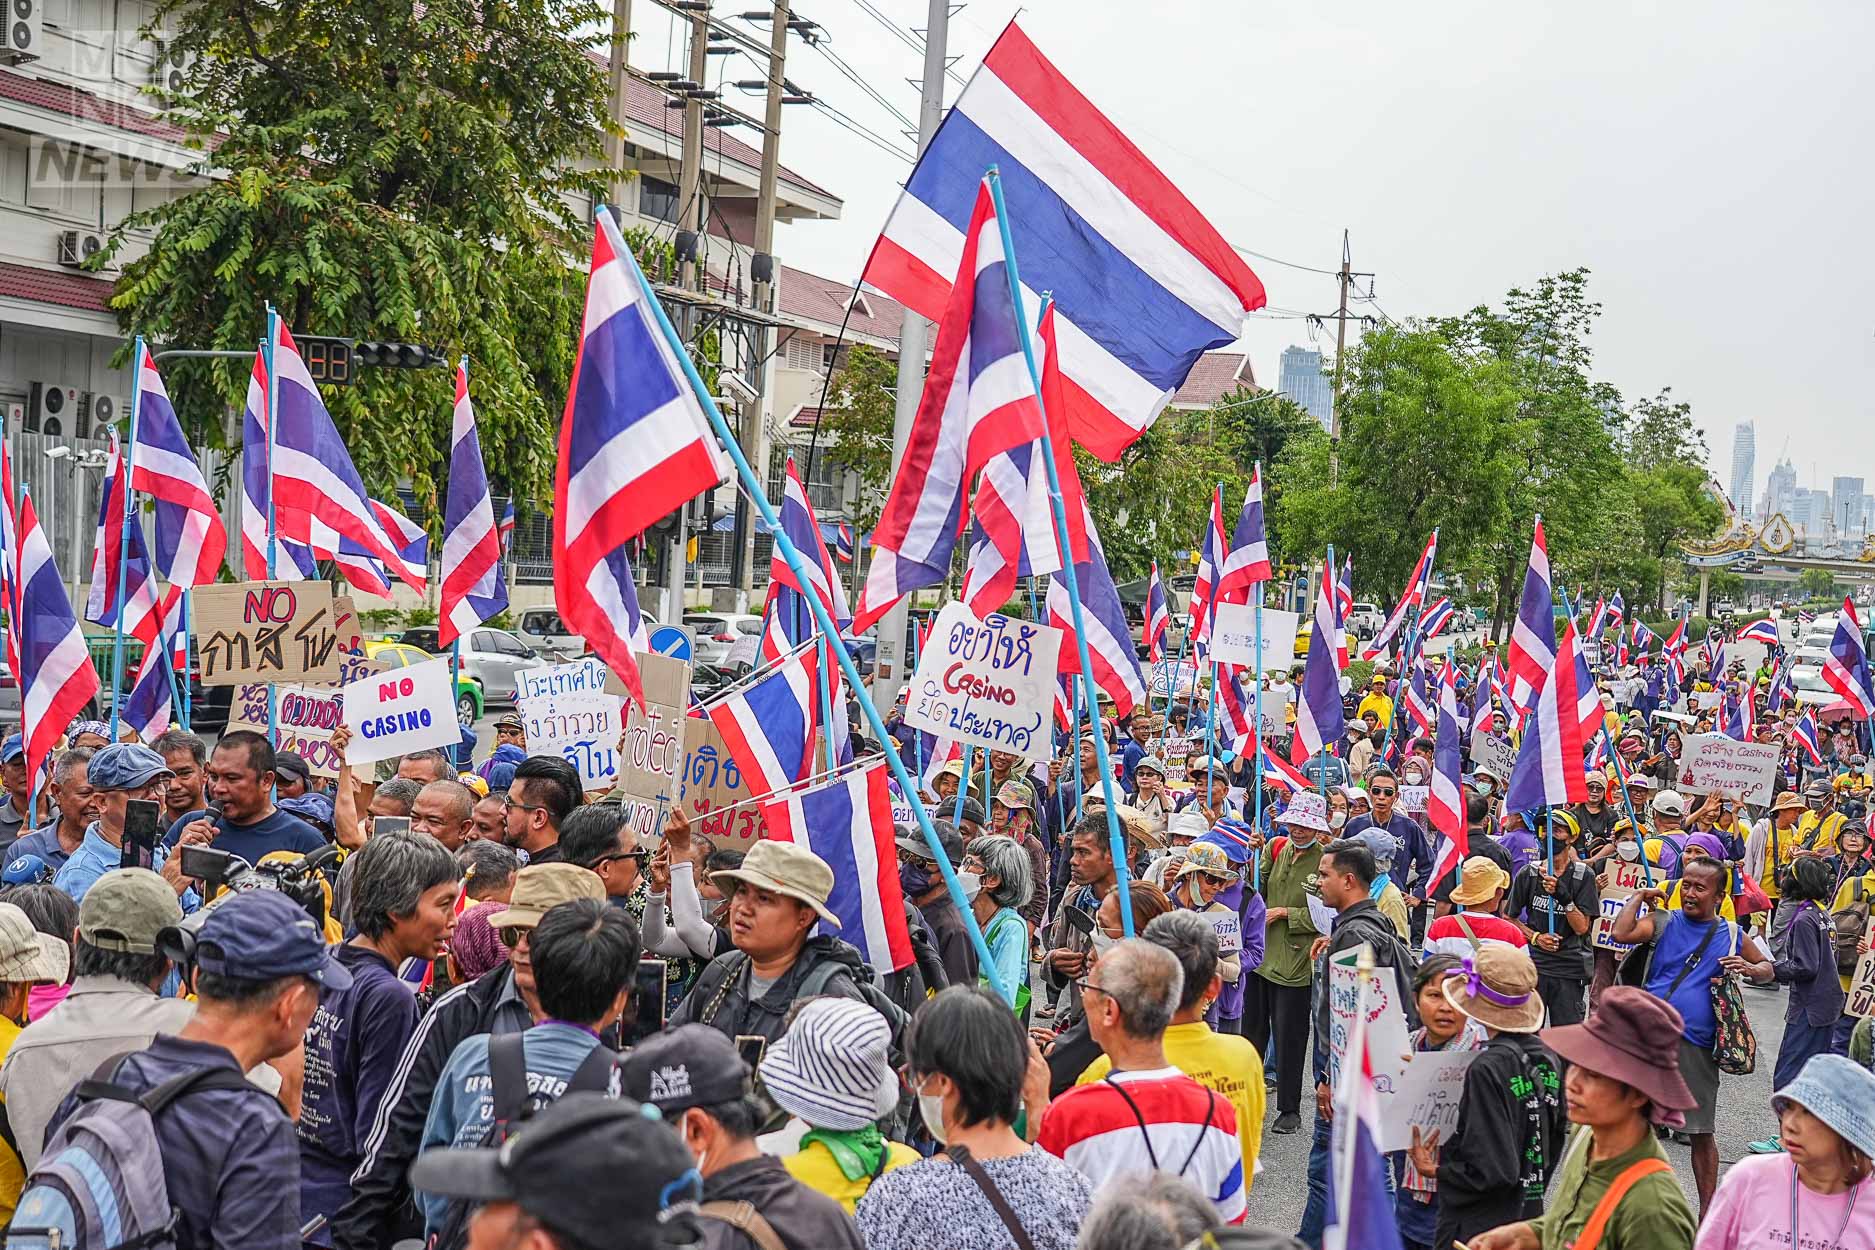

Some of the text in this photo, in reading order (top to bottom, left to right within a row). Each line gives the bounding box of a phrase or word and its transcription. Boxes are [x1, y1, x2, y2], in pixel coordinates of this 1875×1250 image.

[244, 588, 296, 623] NO
[379, 677, 414, 702] NO
[361, 708, 432, 739] CASINO
[1486, 738, 1517, 760] CASIN
